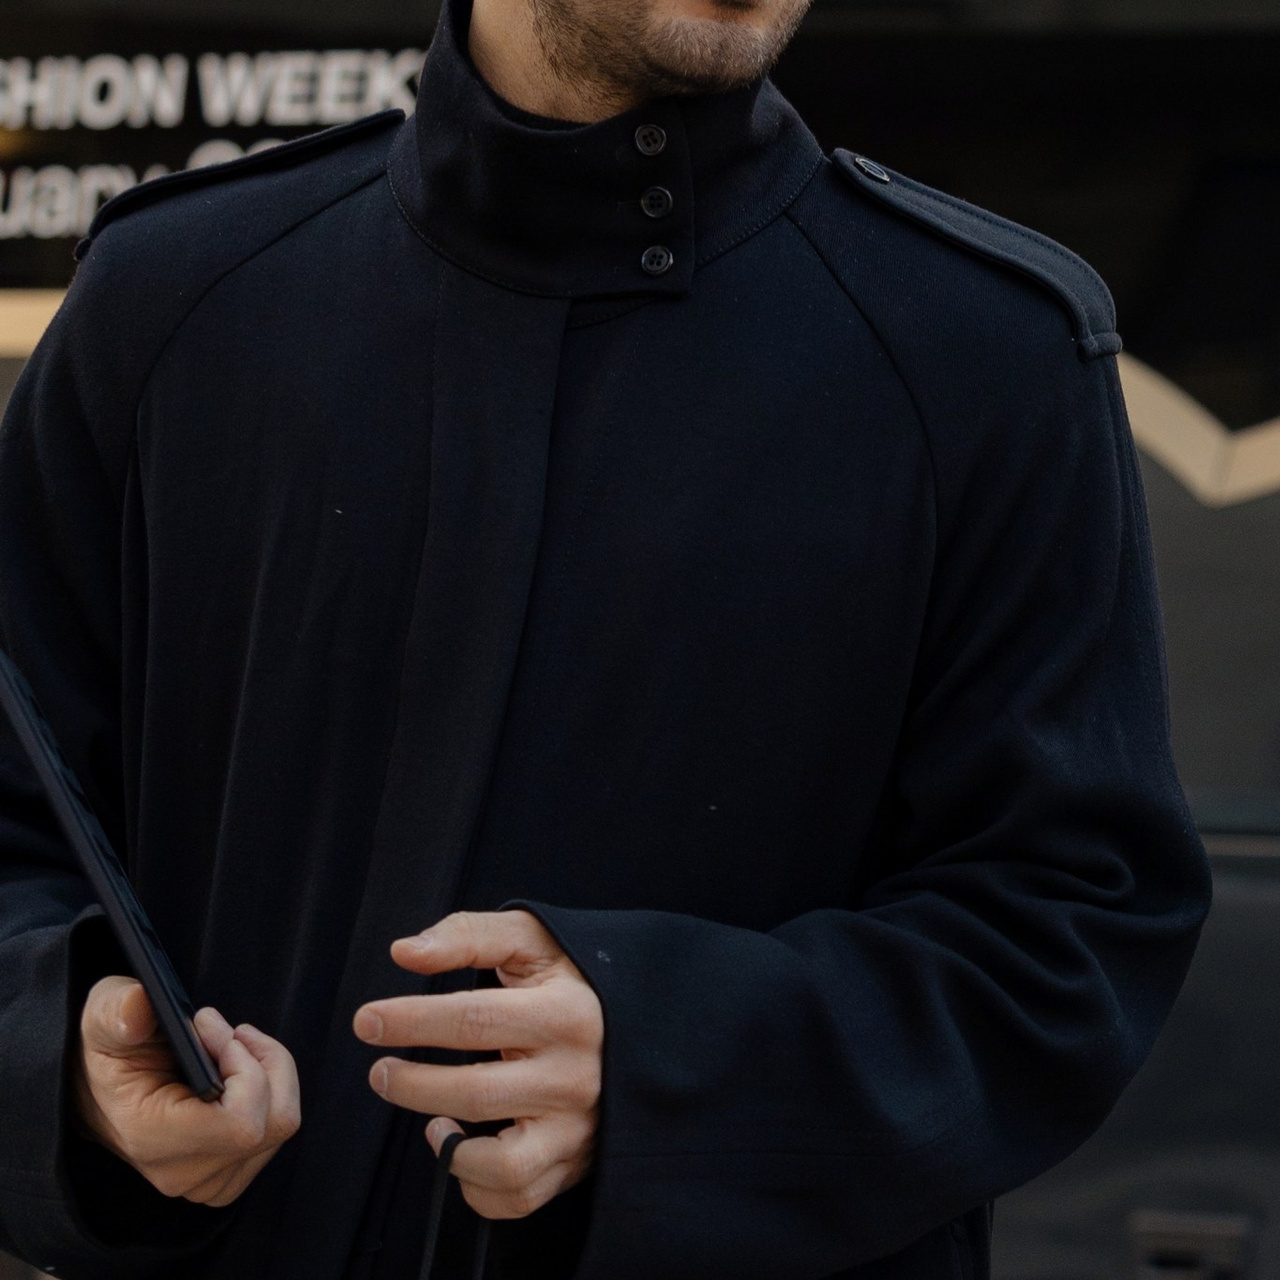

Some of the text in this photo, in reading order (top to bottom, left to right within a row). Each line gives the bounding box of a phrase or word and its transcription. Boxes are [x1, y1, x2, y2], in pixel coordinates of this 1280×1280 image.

[0, 49, 424, 130] HION WEEK
[0, 164, 170, 238] uar
